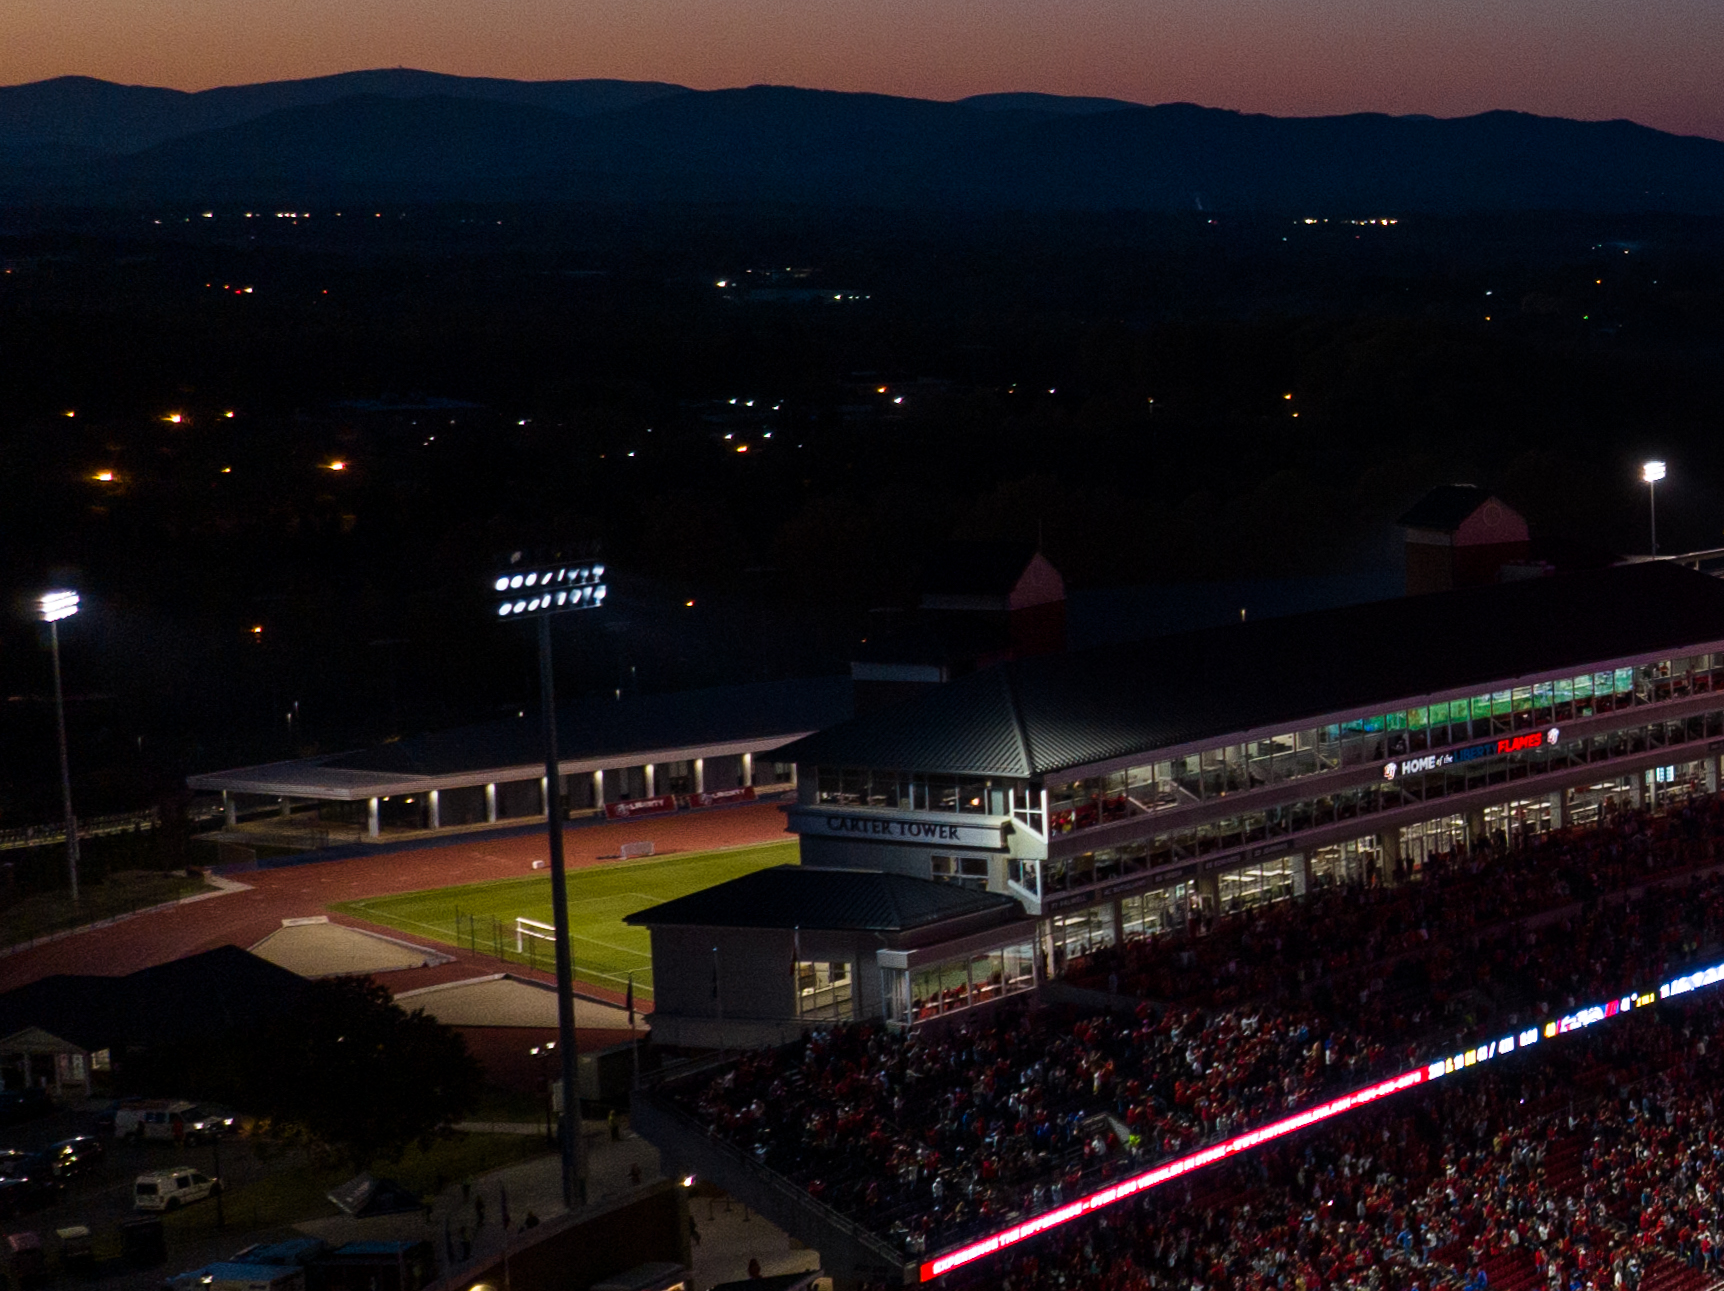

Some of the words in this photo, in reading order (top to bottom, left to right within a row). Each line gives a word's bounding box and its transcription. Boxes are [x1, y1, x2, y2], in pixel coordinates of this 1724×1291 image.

[1402, 755, 1436, 775] HOME
[1454, 741, 1498, 763] LIBERTY
[1498, 732, 1542, 754] FLAMES
[827, 817, 892, 836] CARTER
[900, 821, 960, 841] TOWER
